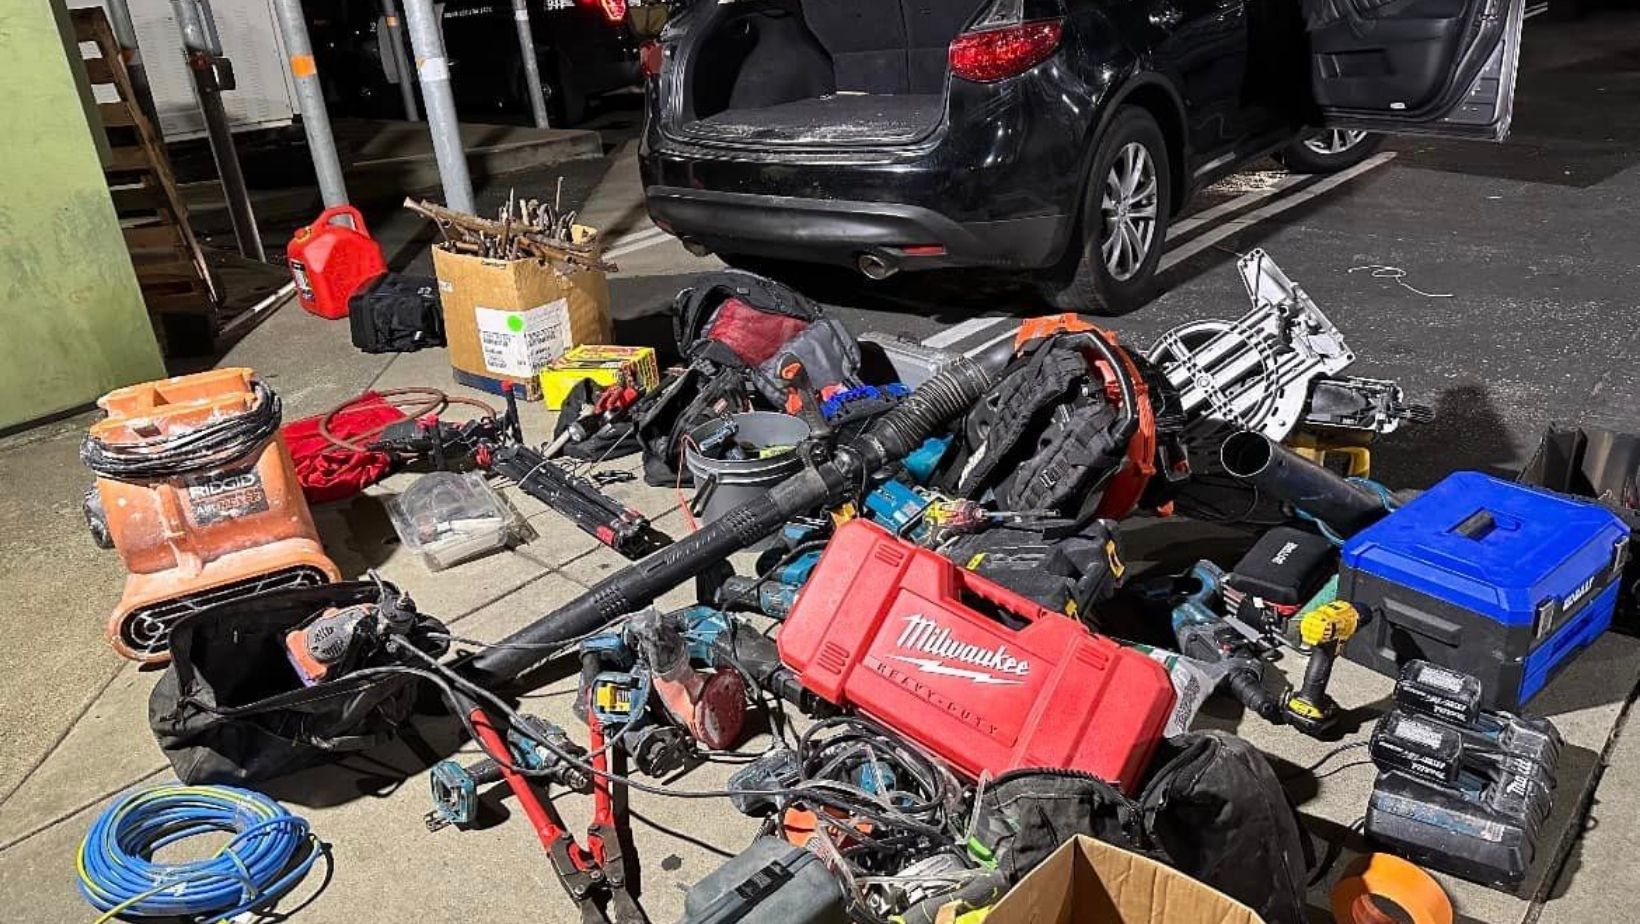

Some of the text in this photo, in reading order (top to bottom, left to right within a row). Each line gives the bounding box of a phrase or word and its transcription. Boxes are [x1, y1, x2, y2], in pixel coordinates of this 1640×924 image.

[189, 473, 256, 499] RIDGID
[896, 613, 1031, 676] Milwaukee
[877, 661, 999, 735] HEAVY-DUTY
